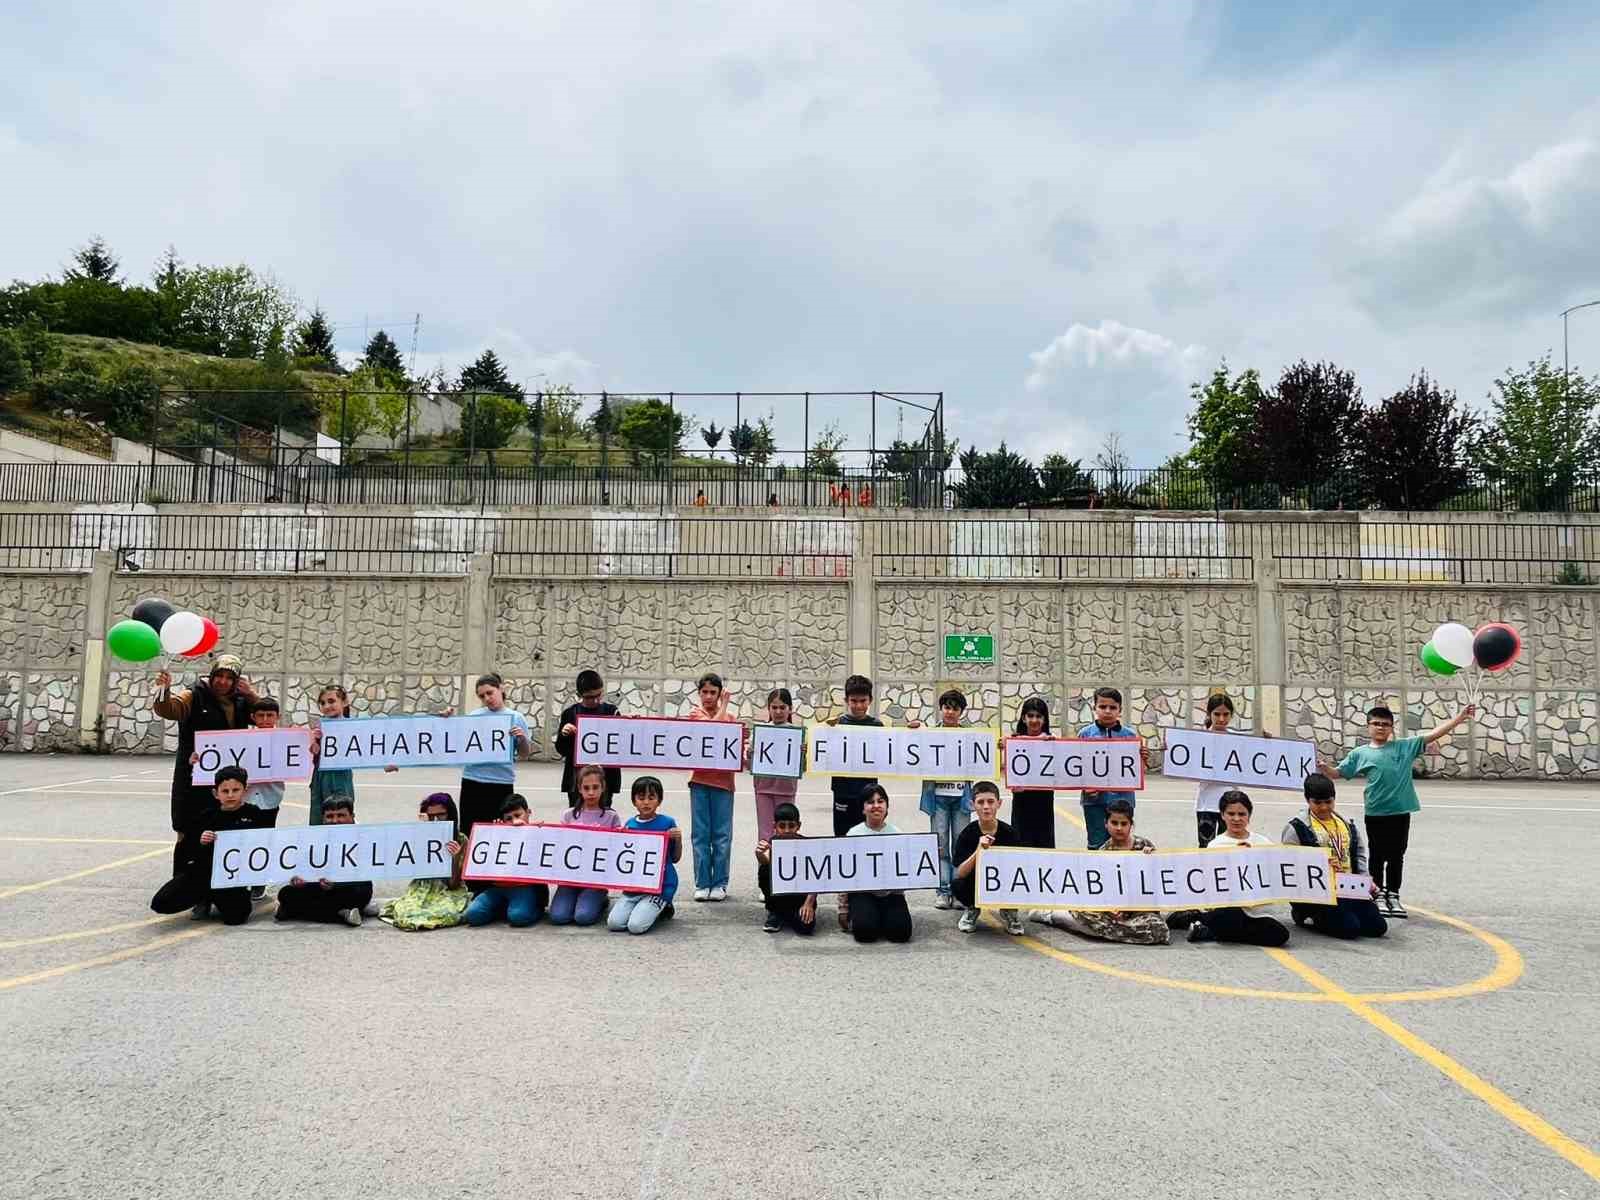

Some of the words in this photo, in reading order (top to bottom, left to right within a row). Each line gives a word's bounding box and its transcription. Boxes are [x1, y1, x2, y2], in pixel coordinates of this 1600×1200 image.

[199, 744, 301, 772] ÖYLE
[324, 729, 507, 758] BAHARLAR
[581, 732, 740, 760] GELECEK
[759, 738, 792, 766] Kİ
[815, 736, 991, 767] FİLİSTİN
[1011, 749, 1137, 778] ÖZGÜR
[1170, 744, 1312, 779] OLACAK
[223, 839, 444, 879] ÇOCUKLAR
[471, 841, 658, 876] GELECEĞE
[778, 851, 938, 881] UMUTLA
[985, 863, 1328, 895] BAKABİLECEKLER
